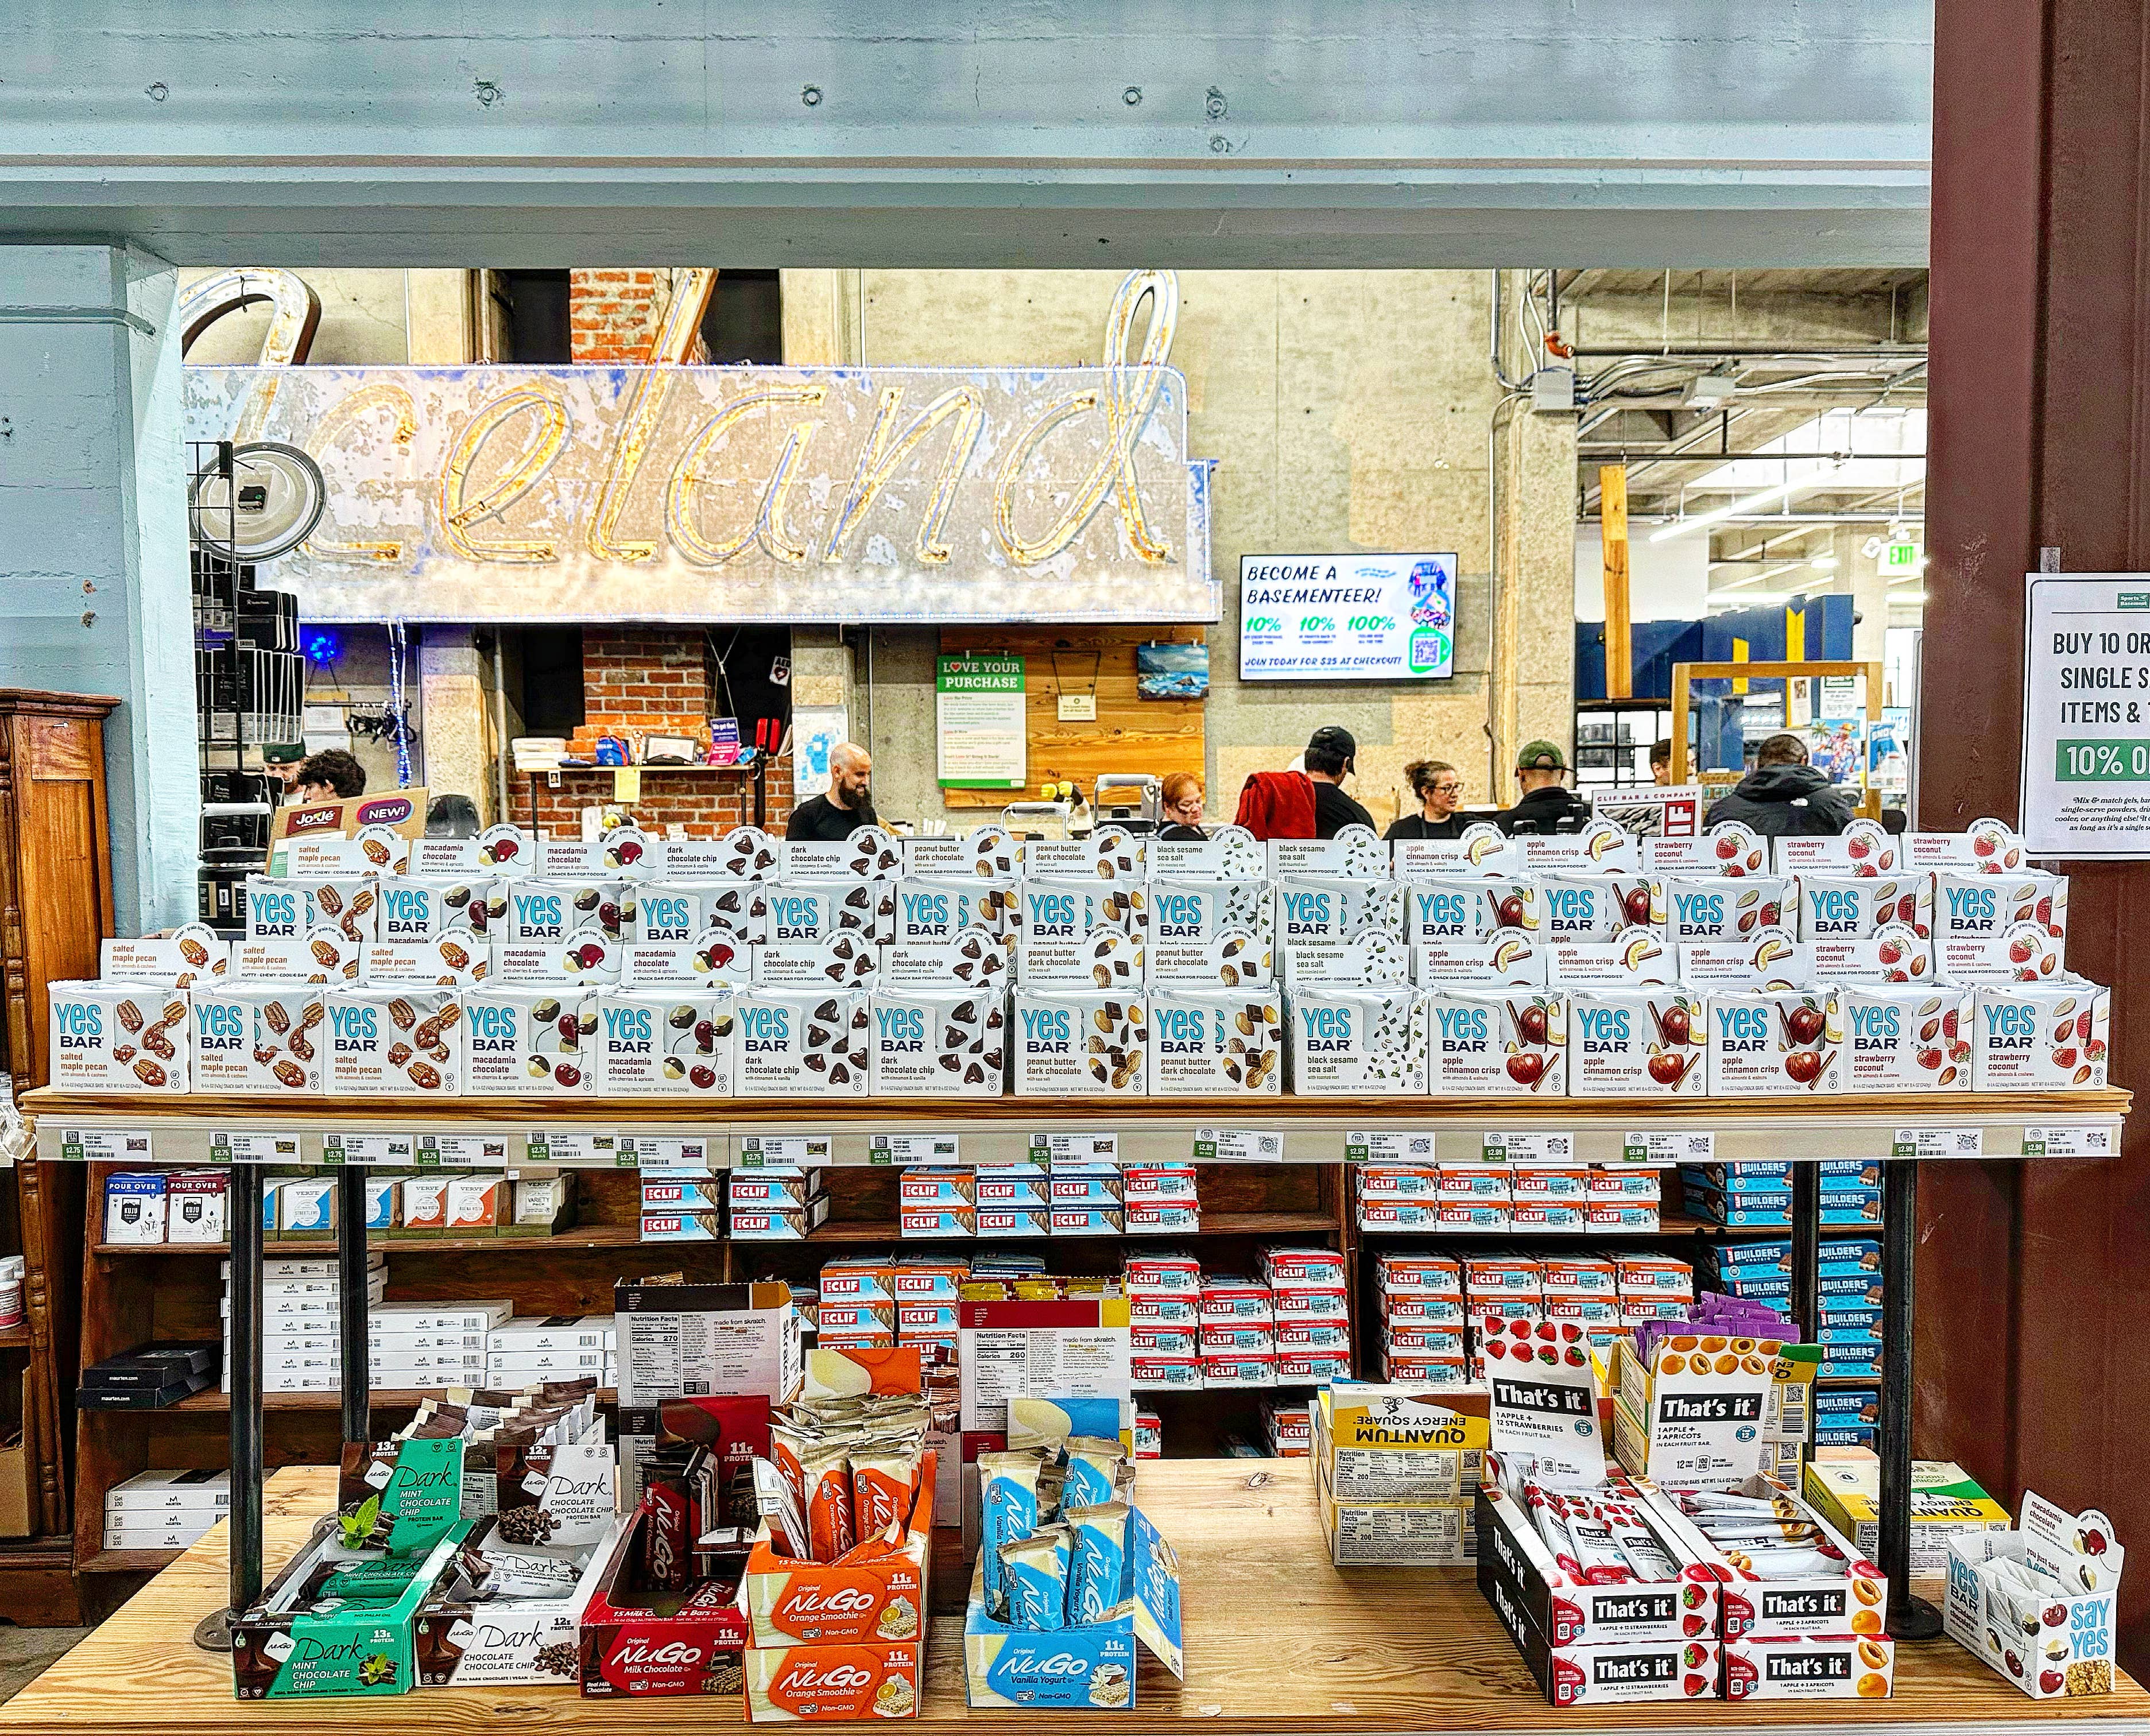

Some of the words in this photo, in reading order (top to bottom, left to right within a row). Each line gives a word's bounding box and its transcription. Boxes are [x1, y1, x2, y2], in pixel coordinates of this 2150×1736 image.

[1890, 545, 1915, 565] EXIT
[1248, 566, 1318, 580] BECOME
[1326, 566, 1337, 580] A
[1246, 588, 1382, 603] BASEMENTEER!
[1245, 617, 1281, 632] 10%
[1299, 617, 1335, 631] 10%
[1347, 616, 1396, 631] 100%
[2054, 633, 2092, 654] BUY
[2099, 633, 2120, 654] 10
[2127, 633, 2150, 654] OR
[1245, 657, 1266, 666] JOIN
[1268, 657, 1298, 666] TODAY
[1300, 657, 1318, 666] FOR
[1340, 657, 1351, 665] AT
[1354, 657, 1402, 665] CHECKOUT!
[983, 662, 1020, 673] YOUR
[945, 677, 1018, 688] PURCHASE
[2061, 667, 2132, 688] SINGLE
[2062, 702, 2120, 723] ITEMS
[2127, 702, 2140, 723] &
[2066, 746, 2123, 775] 10%
[369, 805, 405, 819] NEW!
[915, 845, 937, 854] peanut
[1551, 921, 1593, 931] BAR
[60, 1037, 102, 1048] BAR
[472, 1040, 516, 1051] BAR
[746, 1040, 787, 1052] BAR
[1026, 1041, 1068, 1053] BAR
[1307, 1040, 1349, 1051] BAR
[1443, 1041, 1485, 1052] BAR
[1989, 1038, 2032, 1048] BAR
[472, 1056, 516, 1064] macadamia
[745, 1056, 762, 1064] dark
[1443, 1057, 1463, 1066] apple
[1989, 1054, 2030, 1063] strawberry
[472, 1065, 509, 1074] chocolate
[745, 1065, 781, 1074] chocolate
[784, 1065, 800, 1075] chip
[1322, 1065, 1337, 1073] salt
[1443, 1065, 1481, 1074] cinnamon
[1483, 1065, 1501, 1075] crisp
[1988, 1063, 2019, 1071] coconut
[531, 1146, 547, 1154] $2.75
[1897, 1145, 1913, 1153] $2.99
[1374, 1180, 1396, 1189] CLIF
[653, 1188, 680, 1199] CLIF
[911, 1186, 936, 1196] CLIF
[1741, 1194, 1787, 1208] BUILDERS
[1827, 1313, 1873, 1324] BUILDERS
[1497, 1385, 1558, 1408] That's
[1565, 1390, 1587, 1410] it.
[1665, 1399, 1726, 1417] That's
[1734, 1398, 1755, 1416] it.
[1356, 1416, 1410, 1425] SQUARE
[1413, 1417, 1466, 1425] ENERGY
[1506, 1421, 1563, 1432] STRAWBERRIES
[1356, 1428, 1466, 1443] QUANTUM
[377, 1443, 395, 1451] 13g
[393, 1461, 454, 1488] Dark
[400, 1499, 451, 1507] CHOCOLATE
[400, 1508, 420, 1516] CHIP
[2027, 1547, 2037, 1559] you
[2038, 1552, 2047, 1566] just
[2048, 1560, 2059, 1573] said
[782, 1588, 874, 1613] NuGo
[1595, 1599, 1648, 1618] That's
[1655, 1599, 1672, 1617] it.
[789, 1614, 818, 1622] Orange
[820, 1611, 859, 1621] Smoothie
[479, 1620, 545, 1648] Dark
[720, 1629, 738, 1638] 11g
[611, 1642, 701, 1666] NuGo
[624, 1665, 642, 1673] Milk
[644, 1665, 683, 1673] Chocolate
[998, 1653, 1088, 1676] NuGo
[1011, 1676, 1038, 1684] Vanilla
[1040, 1676, 1066, 1685] Yogurt
